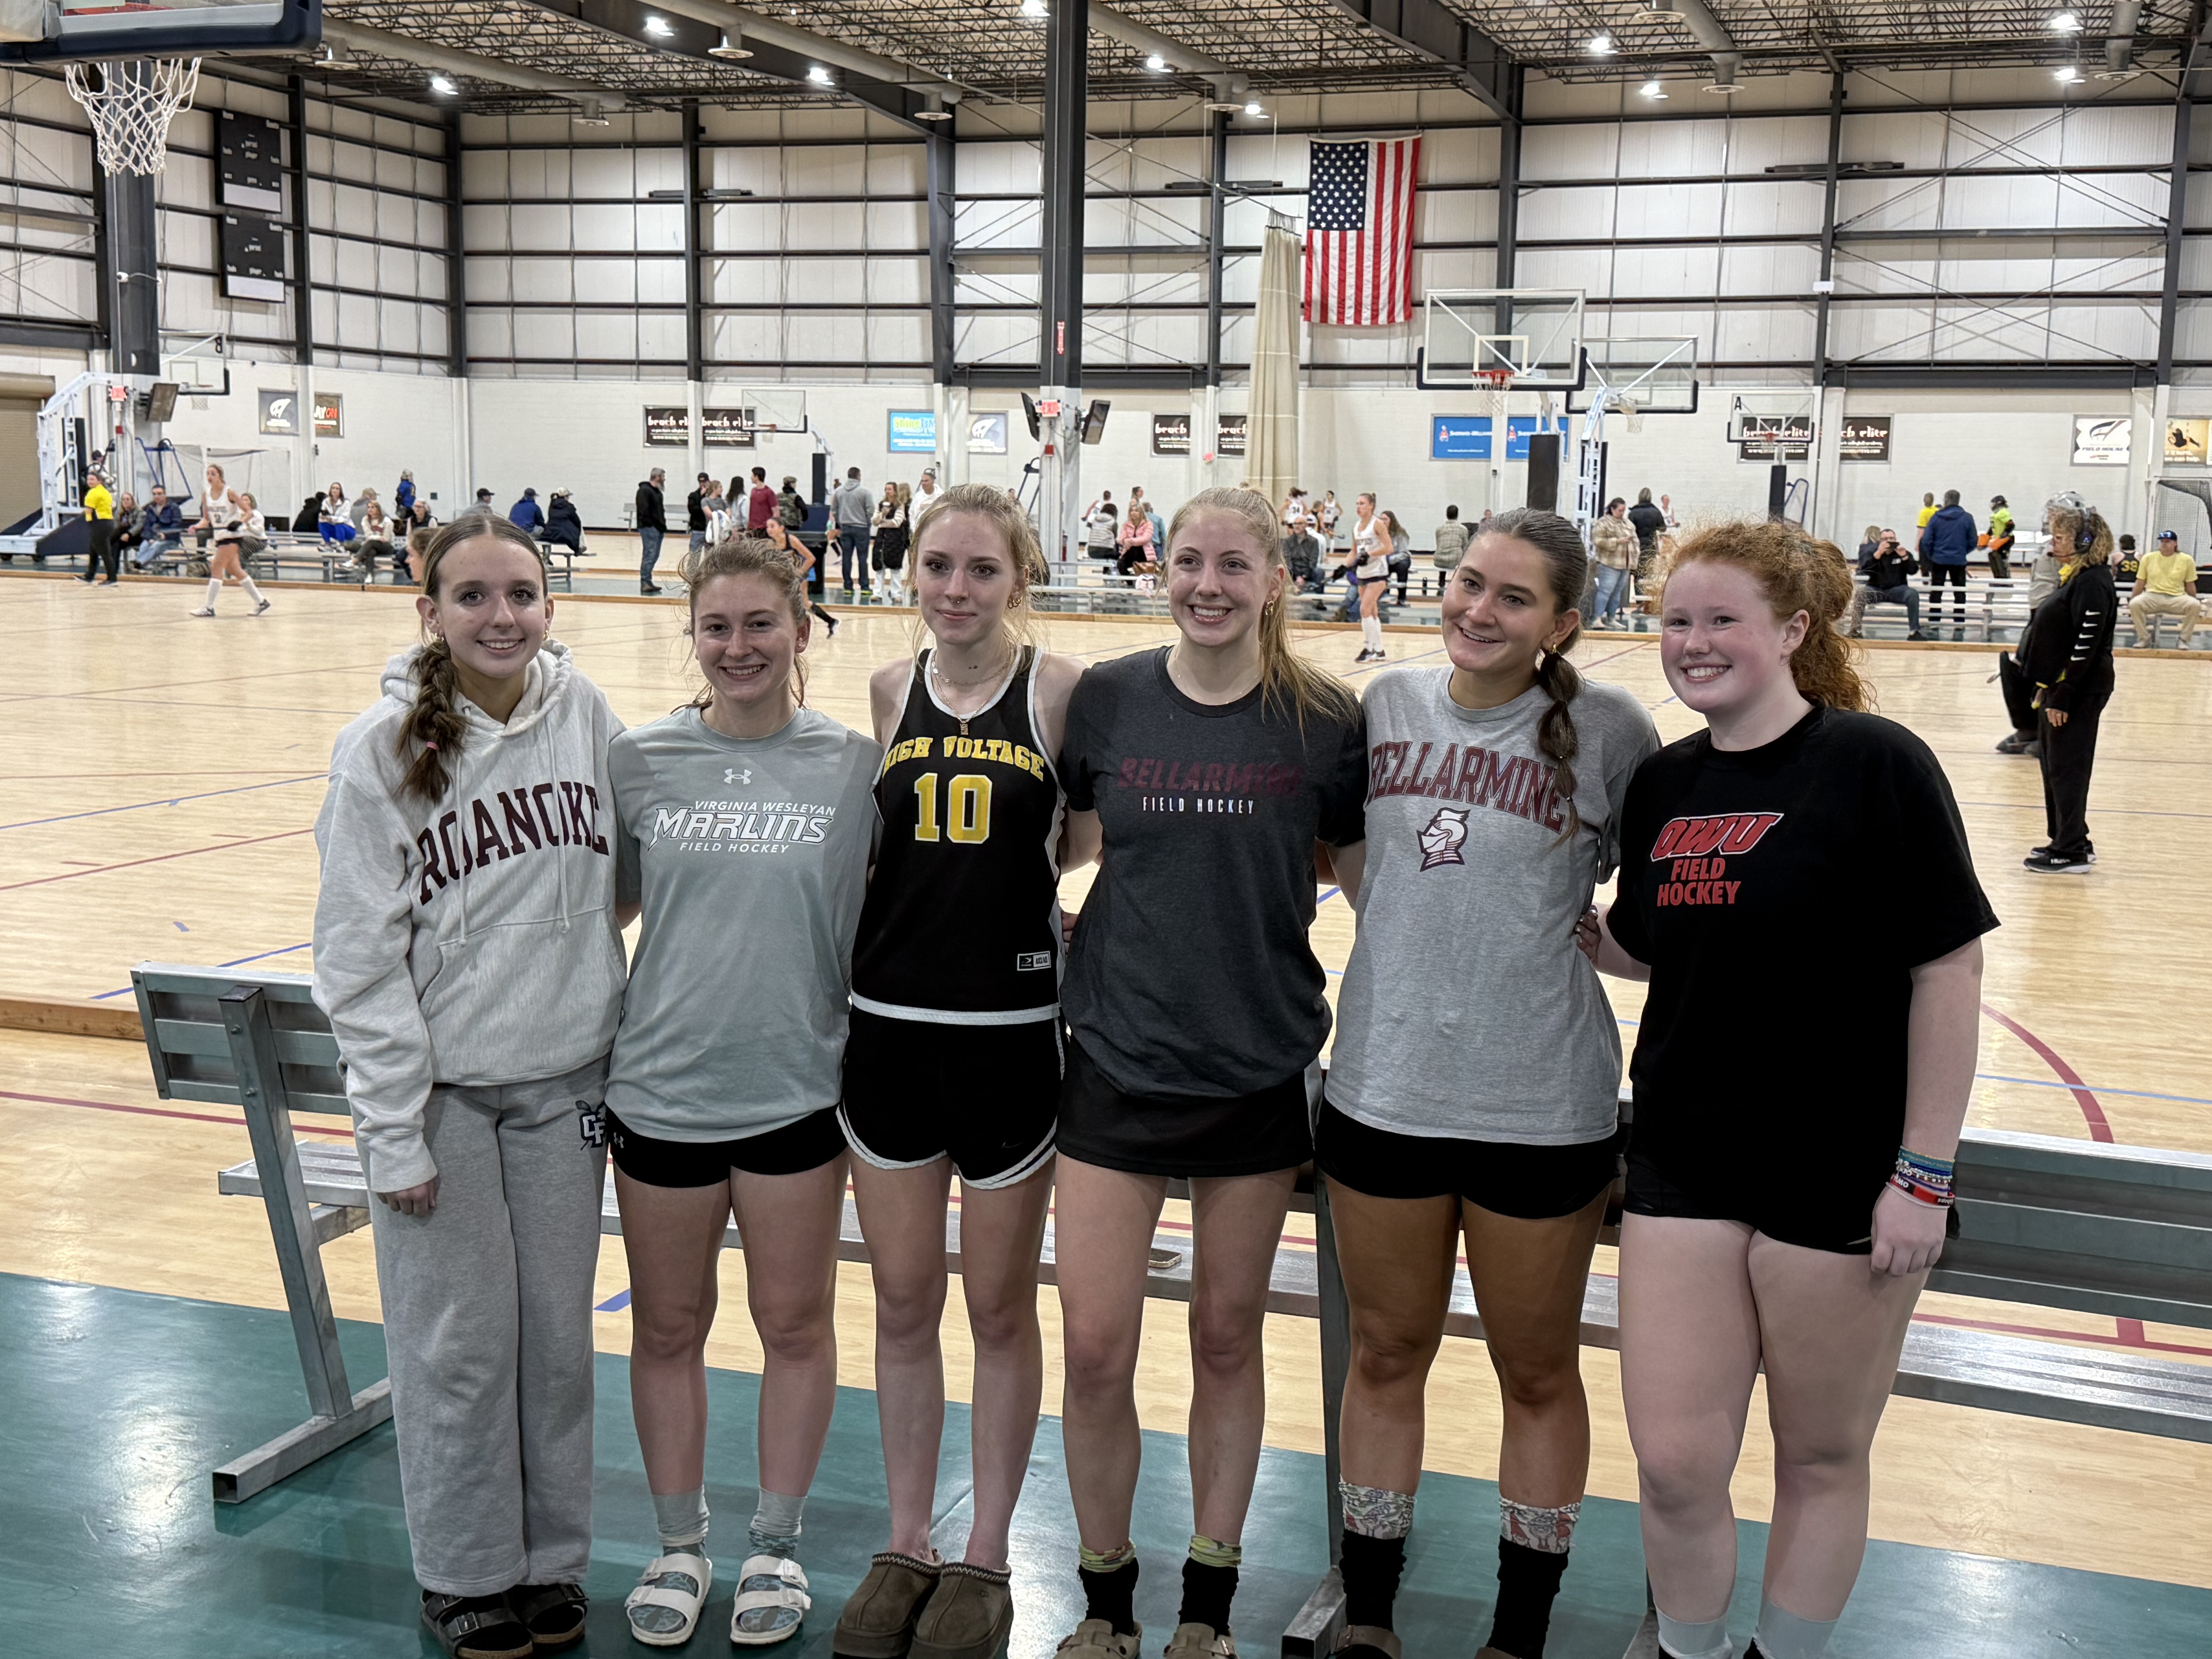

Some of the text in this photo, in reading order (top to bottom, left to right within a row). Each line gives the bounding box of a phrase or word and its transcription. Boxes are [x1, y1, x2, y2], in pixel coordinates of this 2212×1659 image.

[1734, 396, 1742, 410] A
[1859, 425, 1888, 437] elite
[943, 736, 1044, 782] VOLTAGE
[695, 800, 836, 816] VIRGINIA WESLEYAN
[914, 772, 993, 844] 10
[1142, 796, 1254, 814] FIELD HOCKEY
[647, 806, 834, 851] MARLINS
[1650, 811, 1784, 862] OWU
[679, 842, 790, 854] FIELD HOCKEY
[1670, 857, 1726, 881] FIELD
[1657, 881, 1741, 907] HOCKEY
